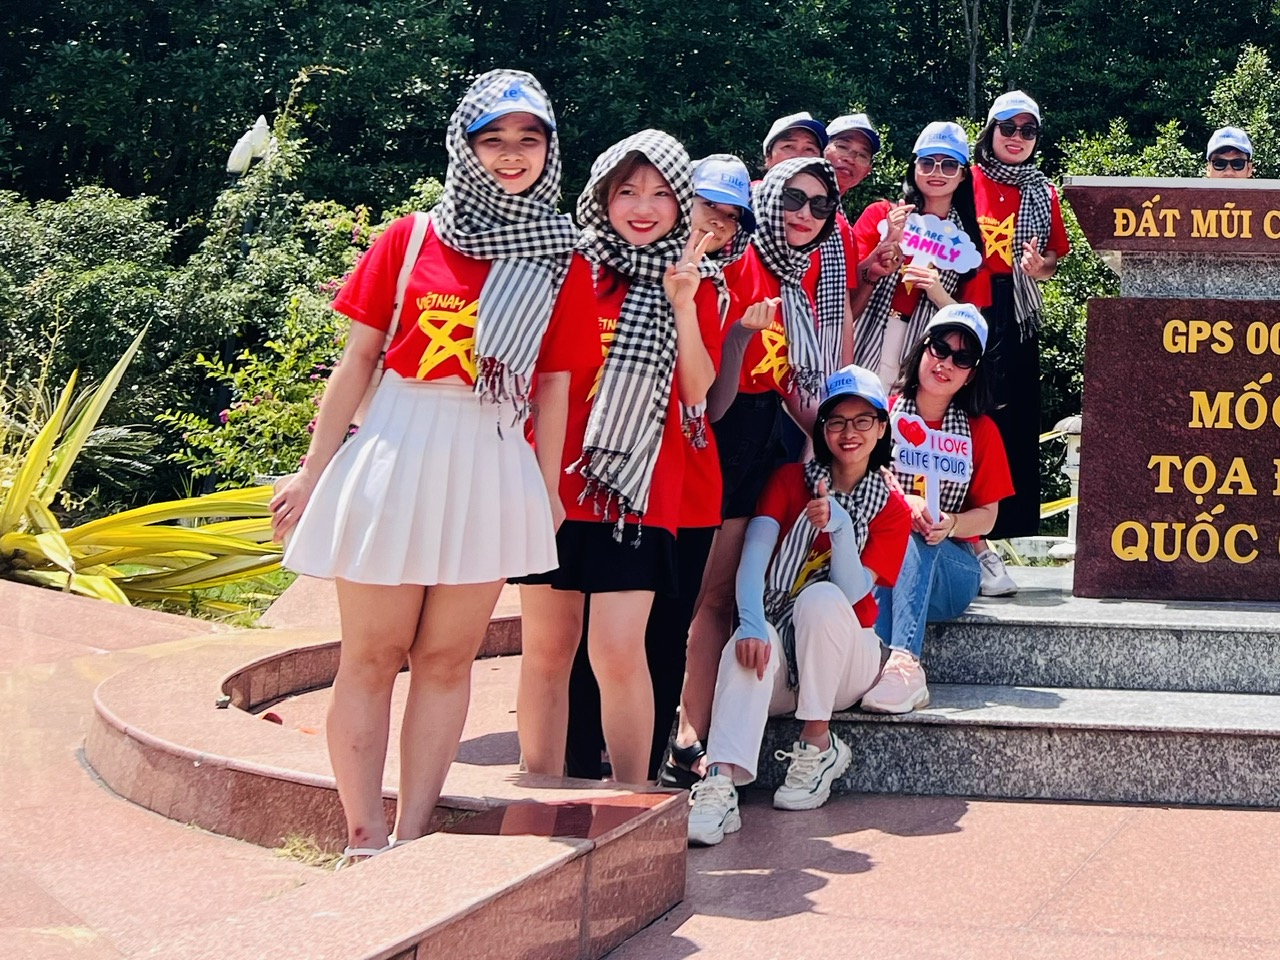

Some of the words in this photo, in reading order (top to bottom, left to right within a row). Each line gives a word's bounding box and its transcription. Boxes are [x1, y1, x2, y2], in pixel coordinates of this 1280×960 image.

[909, 224, 921, 235] WE
[924, 230, 945, 242] ARE
[1113, 195, 1181, 238] ĐẤT
[1190, 202, 1253, 239] MŨI
[902, 231, 961, 263] FAMILY
[1162, 320, 1234, 355] GPS
[899, 449, 929, 469] ELITE
[933, 455, 966, 476] TOUR
[937, 438, 968, 456] LOVE
[1147, 455, 1258, 505] TỌA
[1110, 503, 1259, 565] QUỐC
